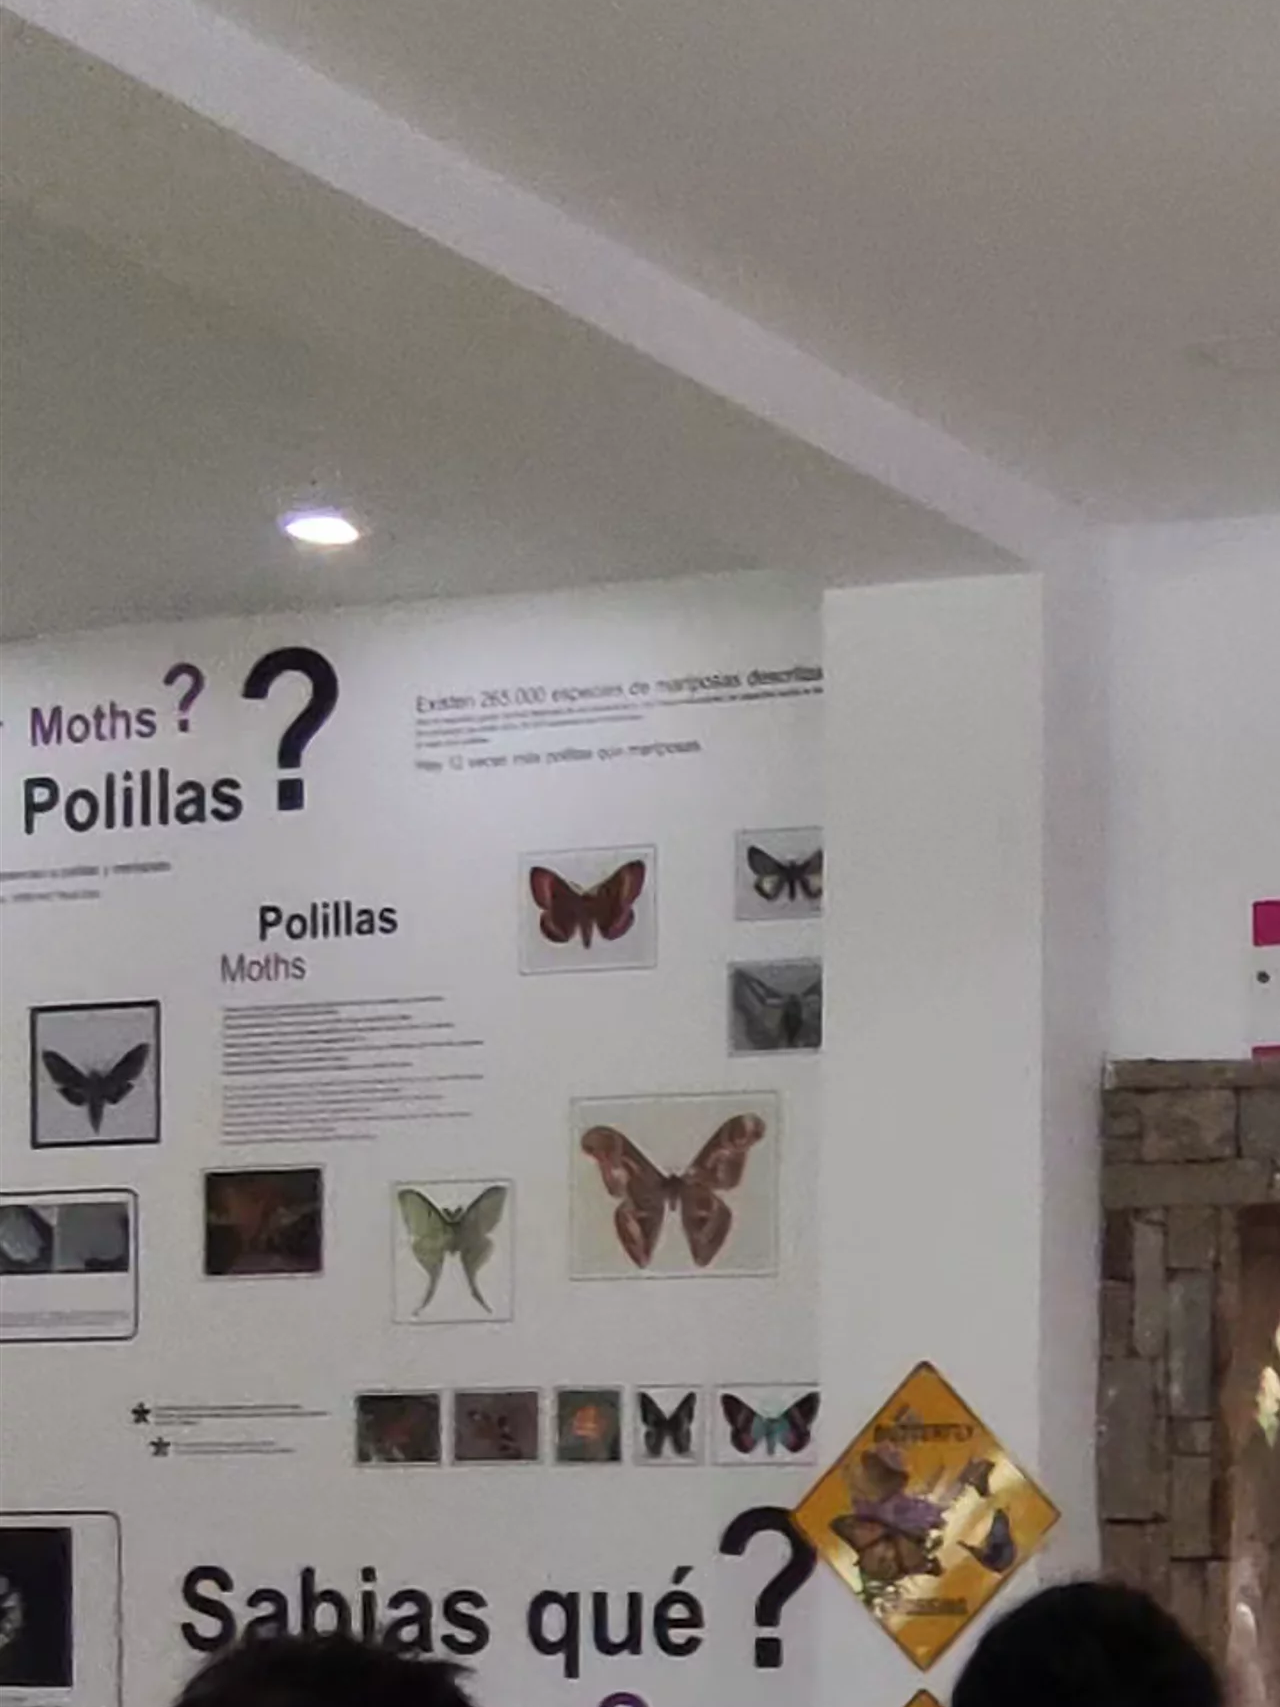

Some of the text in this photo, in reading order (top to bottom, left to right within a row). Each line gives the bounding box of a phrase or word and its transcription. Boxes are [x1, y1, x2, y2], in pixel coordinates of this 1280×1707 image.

[30, 700, 157, 746] Moths
[23, 768, 243, 835] Polillas
[259, 901, 398, 942] Polillas
[221, 953, 306, 983] Moths
[181, 1565, 491, 1656] Sabias
[527, 1565, 706, 1679] qué
